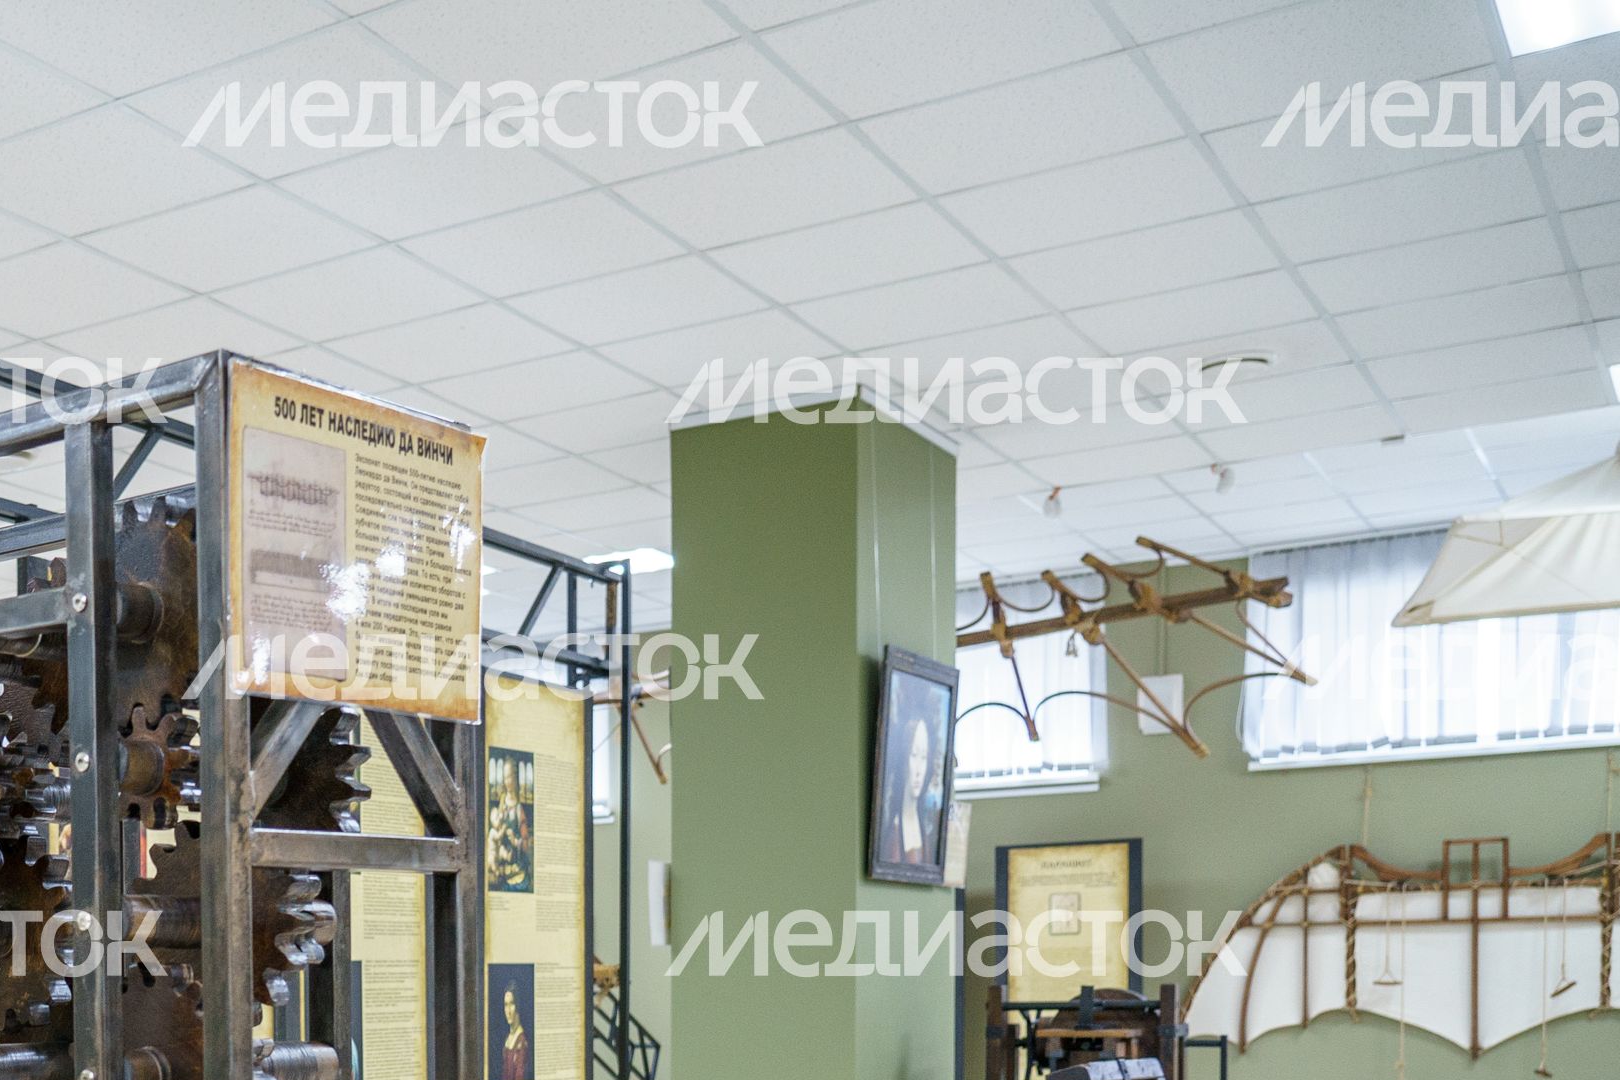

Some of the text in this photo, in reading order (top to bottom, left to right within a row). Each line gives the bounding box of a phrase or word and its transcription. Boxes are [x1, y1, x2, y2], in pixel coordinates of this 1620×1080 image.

[274, 395, 453, 466] 500 ЛЕТ НАСЛЕДИЮ ДА ВИНЧИ
